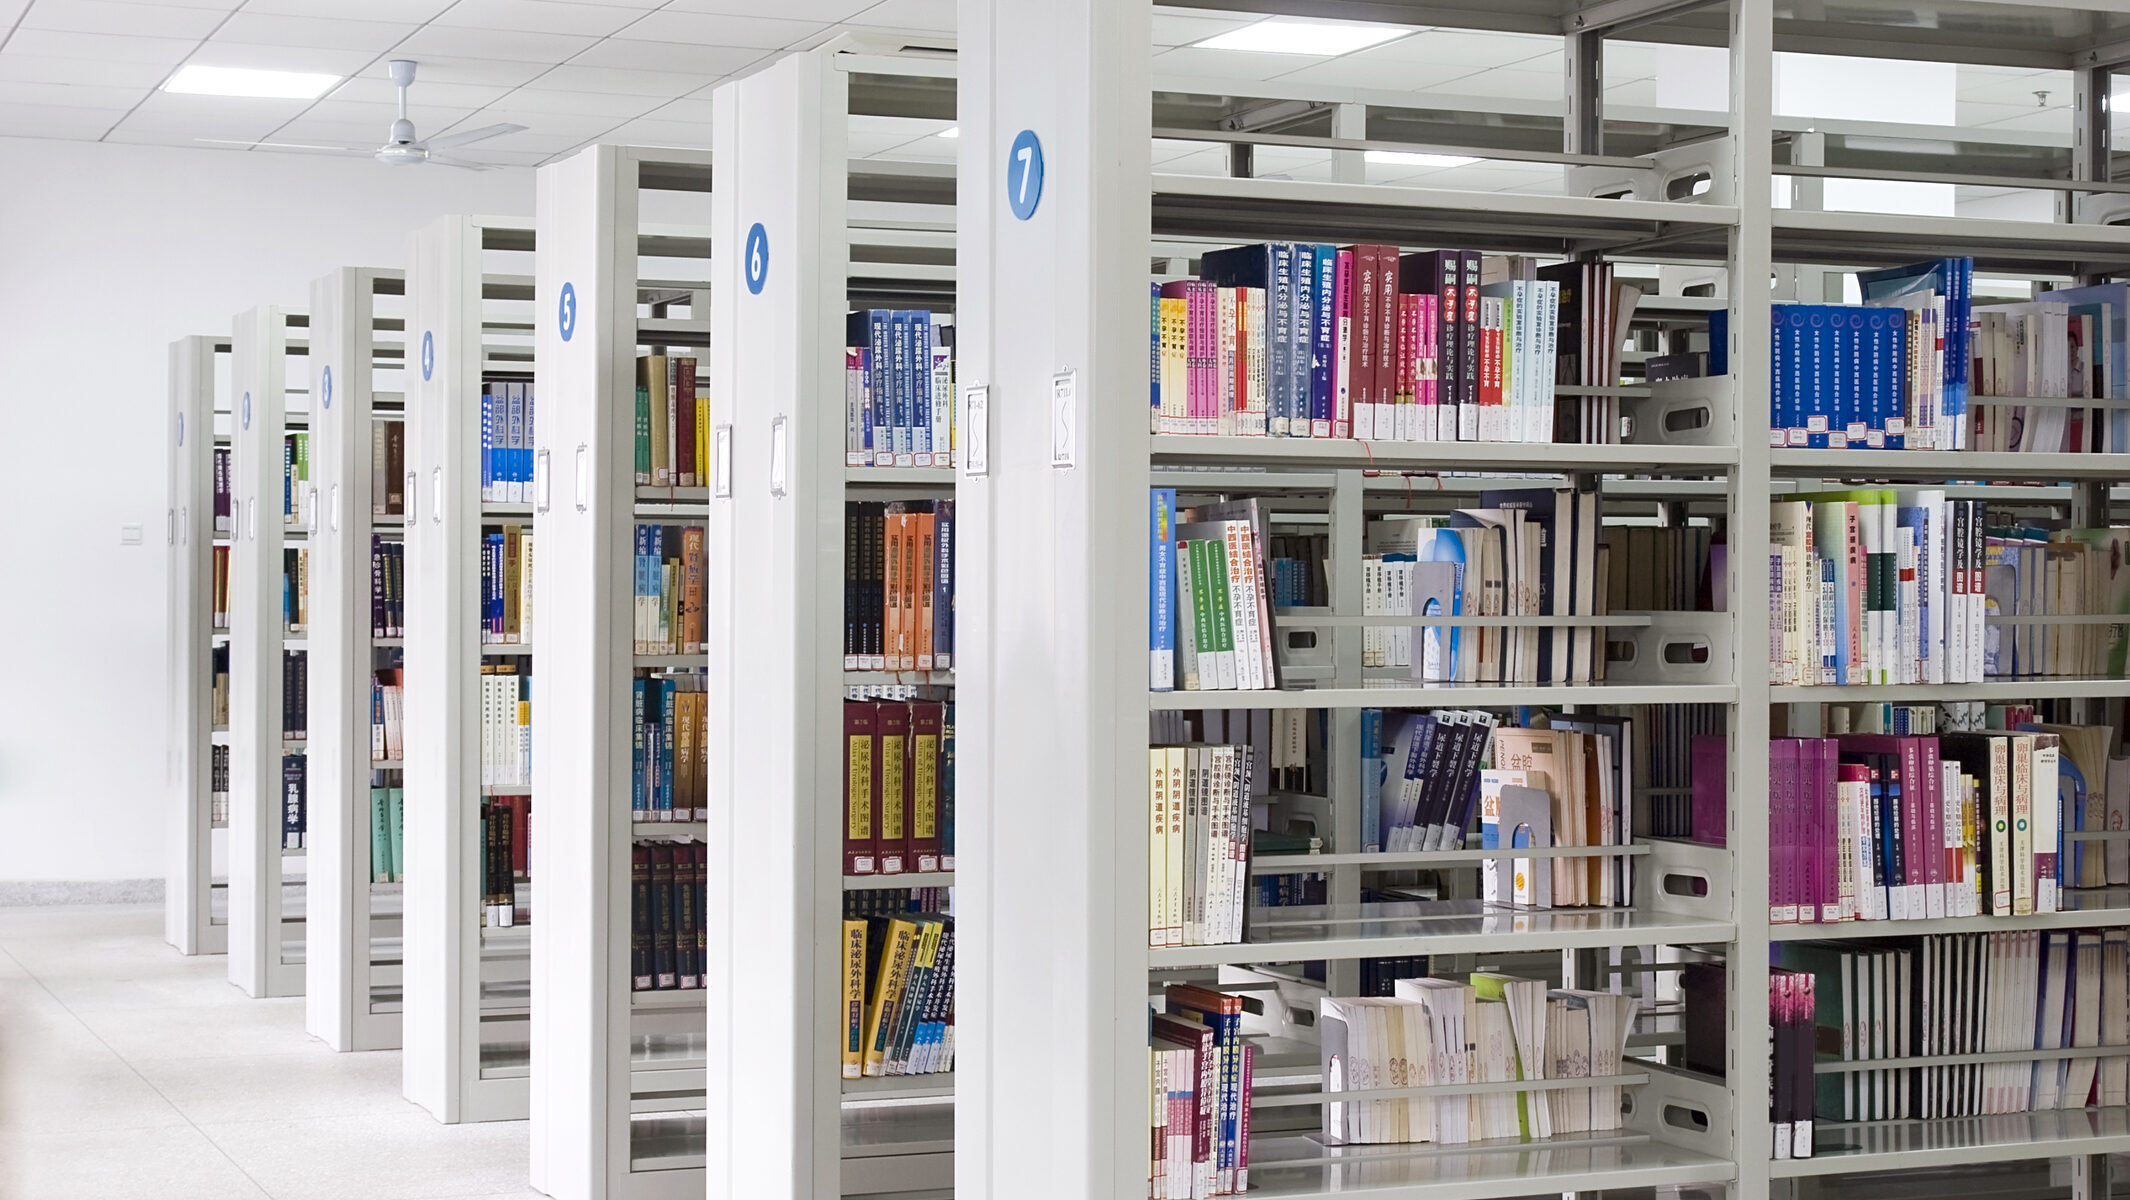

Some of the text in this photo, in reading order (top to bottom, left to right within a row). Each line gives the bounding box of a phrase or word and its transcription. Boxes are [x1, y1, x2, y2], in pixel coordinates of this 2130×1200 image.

[1017, 147, 1033, 204] 7
[751, 236, 761, 278] 6
[563, 296, 571, 328] 5
[1228, 296, 1236, 346] 不孕不育
[1277, 251, 1289, 344] 临床生殖内分泌与不育症
[1299, 251, 1312, 344] 临床生殖内分泌与不育症
[1320, 258, 1333, 343] 临床生殖内分泌与不育症
[424, 340, 430, 371] 4
[287, 783, 299, 824] 乳腺病学
[860, 739, 870, 837] 泌尿外科手术图谱
[893, 739, 902, 836] 泌尿外科手术图谱
[925, 739, 935, 835] 泌尿外科手术图谱
[1155, 768, 1163, 835] 外阴阴道疾病
[1172, 767, 1181, 834] 外阴阴道疾病
[1211, 755, 1222, 838] 宫腔镜诊断与手术图谱
[1221, 755, 1232, 838] 宫腔镜诊断与手术图谱
[1994, 744, 2007, 816] 卵巢临床与病理
[2015, 743, 2028, 815] 卵巢临床与病理
[849, 929, 862, 1000] 临床泌尿外科学
[885, 930, 911, 1000] 临床泌尿外科学
[1220, 1018, 1231, 1121] 子宫内膜异位症现代治疗
[1229, 1018, 1240, 1121] 子宫内膜异位症现代治疗
